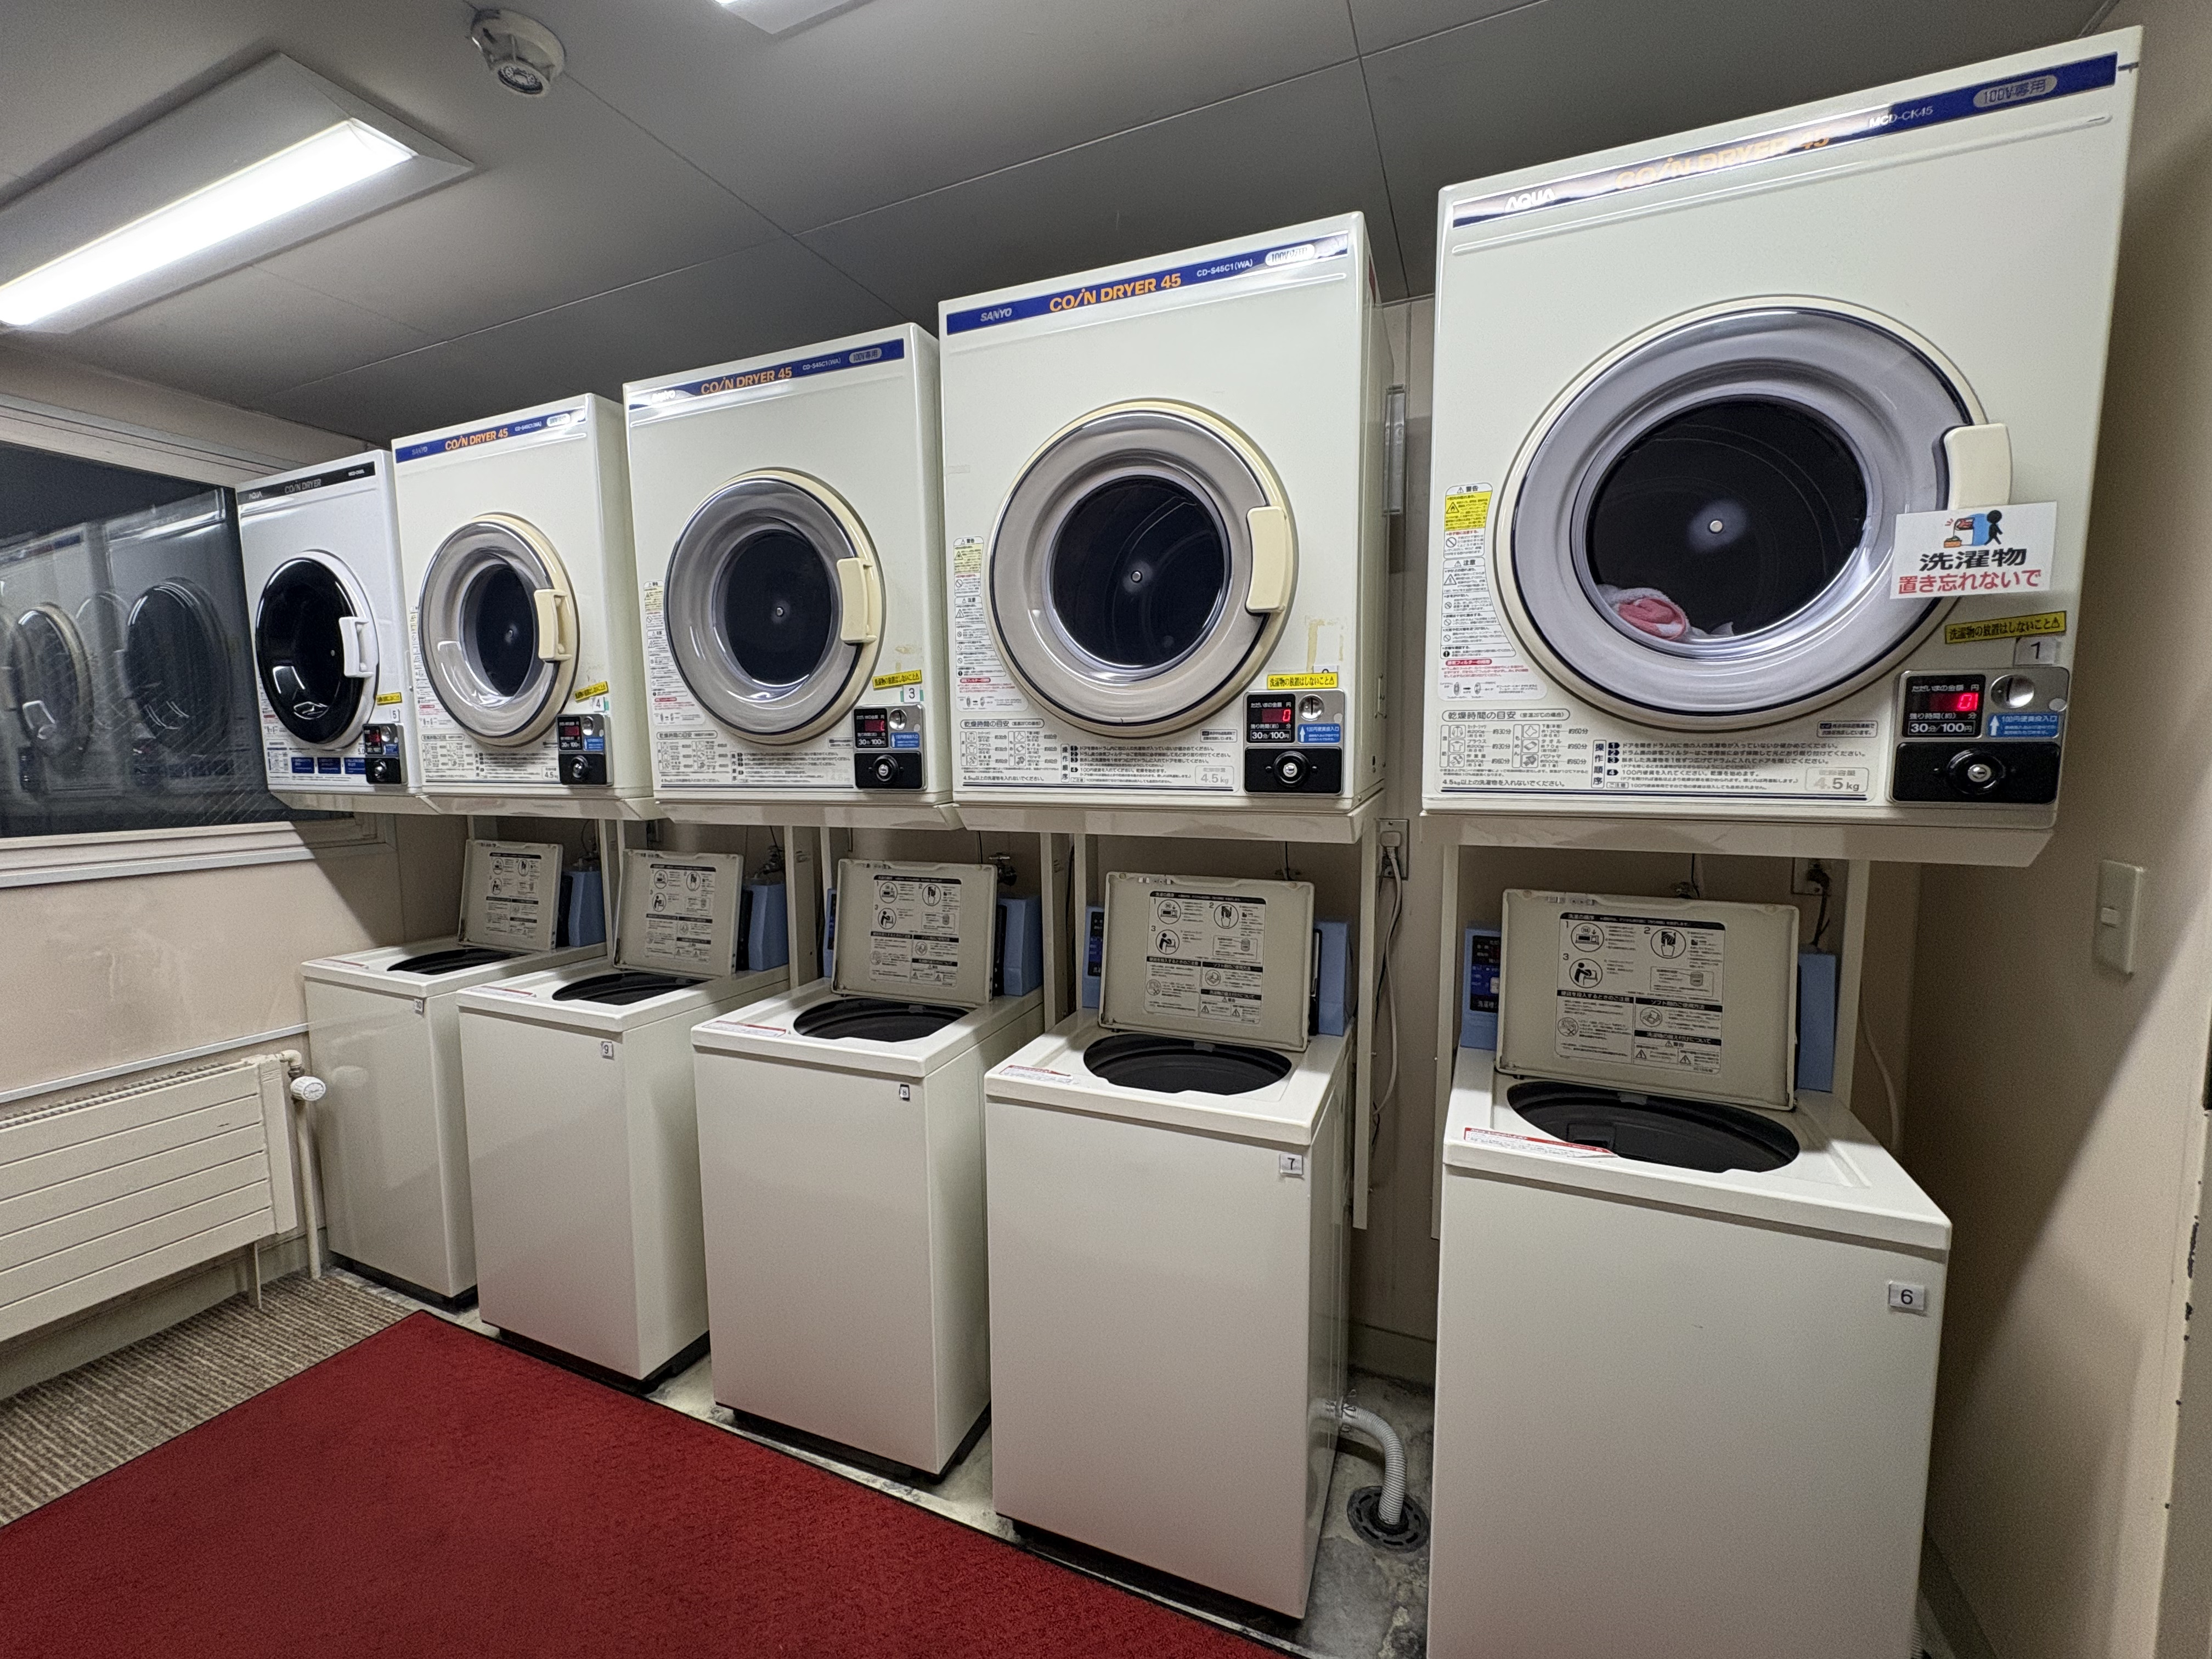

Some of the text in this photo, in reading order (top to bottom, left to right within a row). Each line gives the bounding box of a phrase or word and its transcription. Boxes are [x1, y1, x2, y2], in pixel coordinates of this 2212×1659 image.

[1869, 105, 1934, 128] MCD-CK45
[1800, 129, 1830, 149] 45
[1504, 188, 1556, 212] AQUA
[1196, 258, 1254, 277] CD-S45C1(WA)
[1101, 279, 1157, 303] DRYER
[1161, 273, 1182, 290] 45
[980, 308, 1013, 323] SANYO
[737, 370, 775, 389] DRYER
[778, 366, 793, 379] 45
[470, 431, 496, 445] DRYER
[498, 428, 509, 438] 45
[302, 478, 322, 490] DRYER
[1919, 548, 2028, 572] 洗濯物
[1898, 569, 2042, 595] 置き忘れないで
[2030, 641, 2041, 659] 1
[909, 687, 915, 699] 3
[596, 698, 601, 708] 4
[392, 710, 397, 719] 5
[1282, 709, 1291, 722] 0
[1448, 711, 1516, 720] 乾燥時間の目安
[604, 1044, 609, 1054] 9
[1287, 1157, 1296, 1170] 7
[1900, 1289, 1914, 1305] 6
